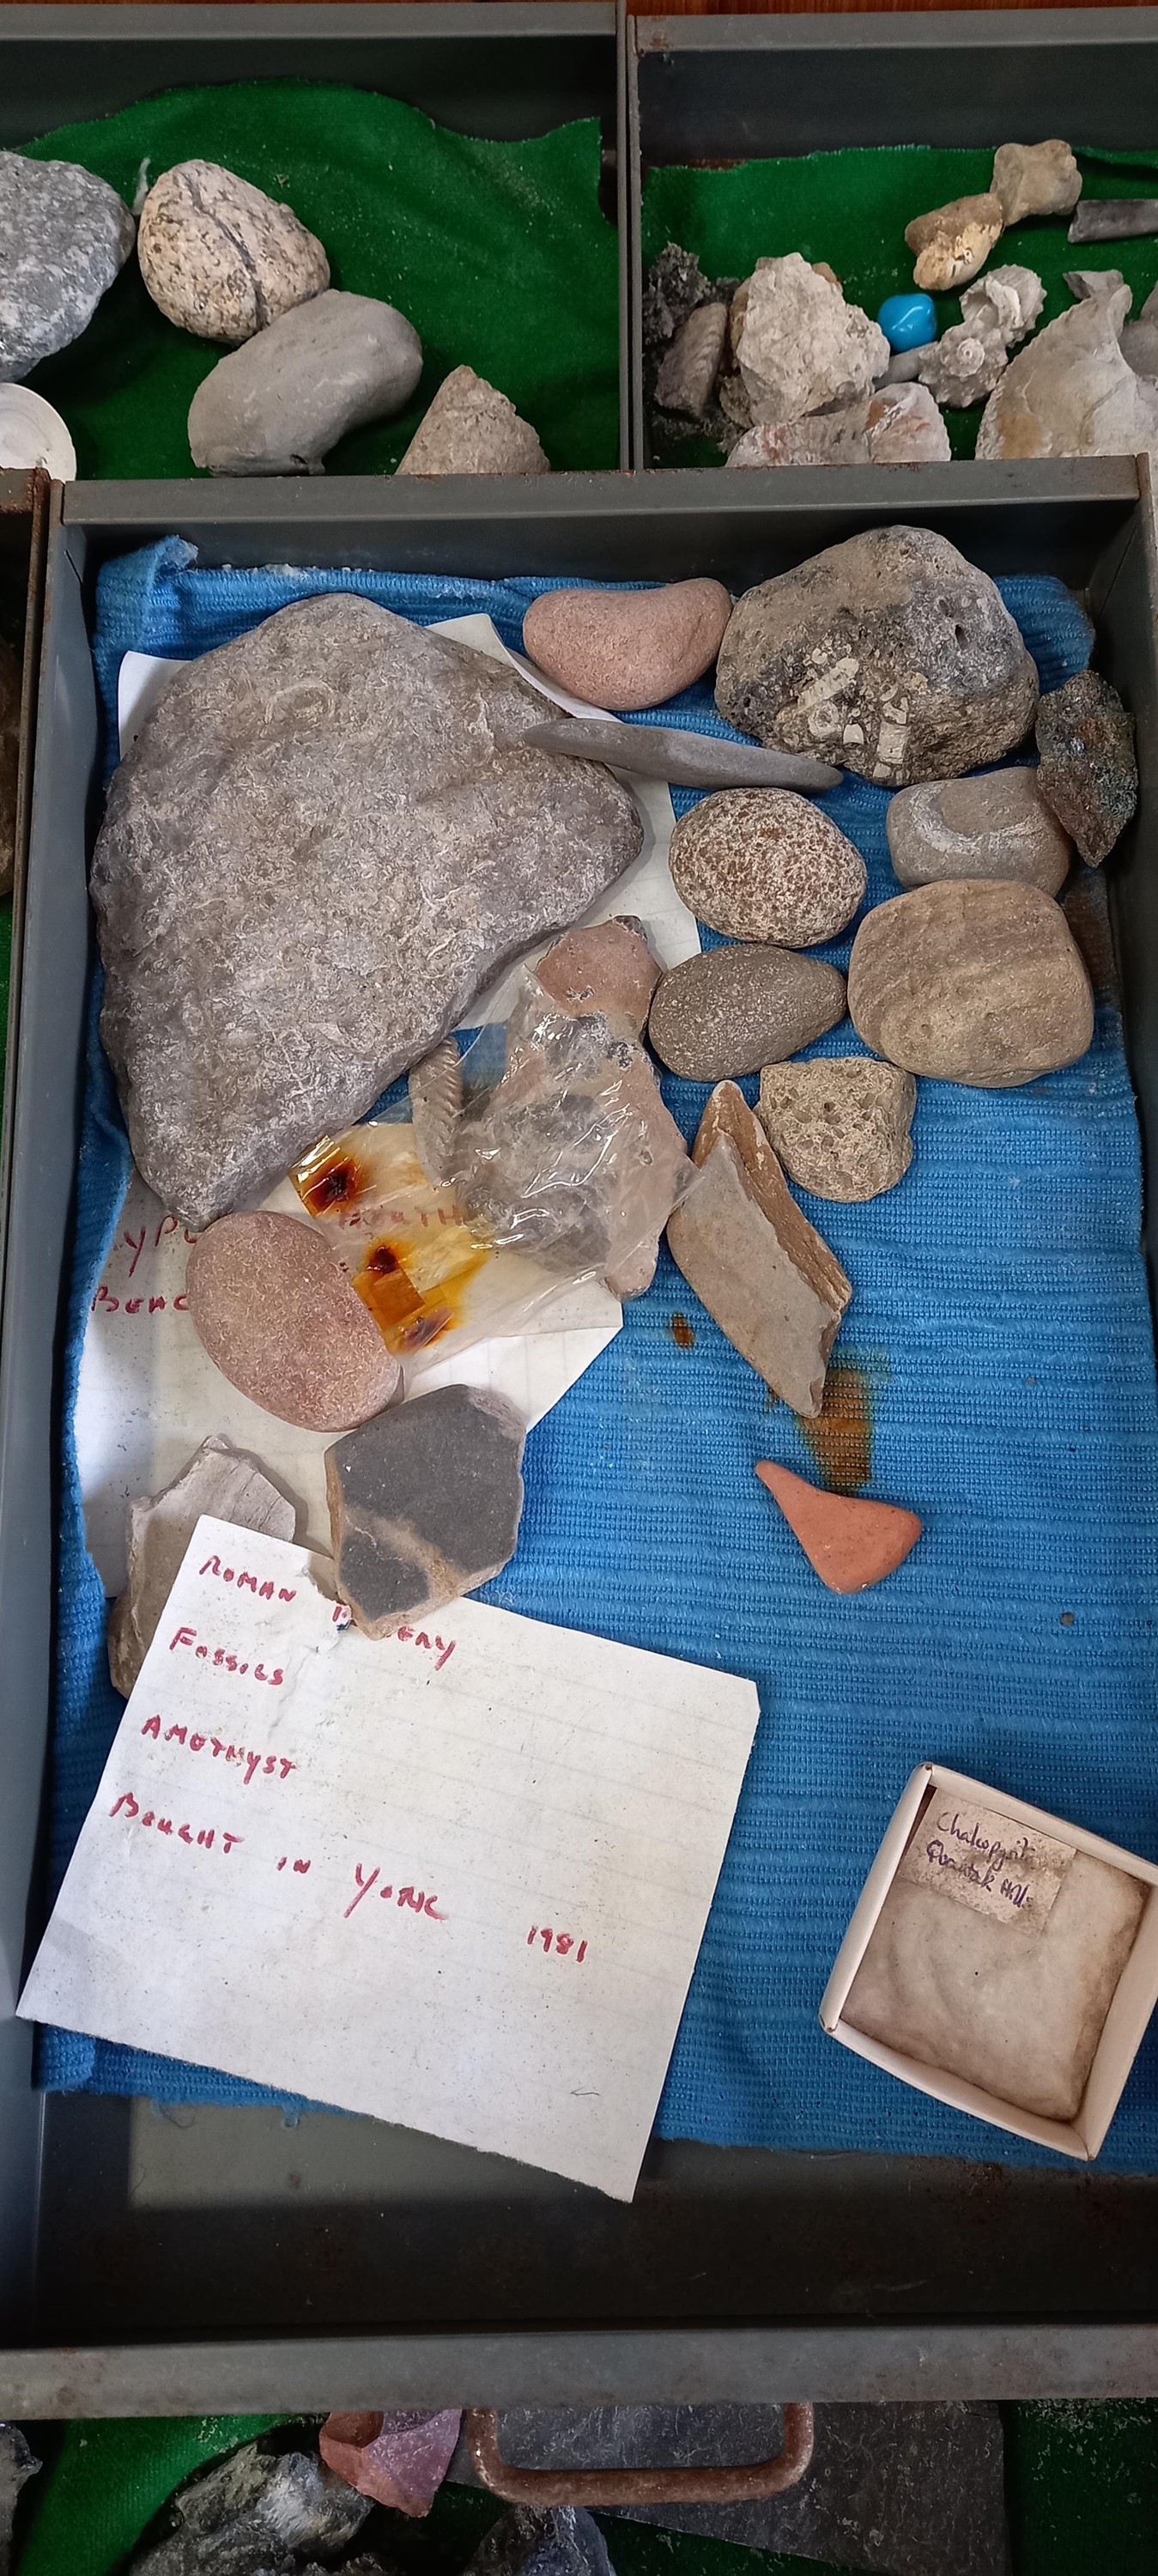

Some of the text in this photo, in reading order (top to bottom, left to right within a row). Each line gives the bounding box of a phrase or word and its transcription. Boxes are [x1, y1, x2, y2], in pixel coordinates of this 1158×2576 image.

[198, 1554, 297, 1603] ROMAN
[169, 1626, 285, 1686] FOSSILS
[108, 1791, 589, 1964] BOUGHT IN YORK 1981
